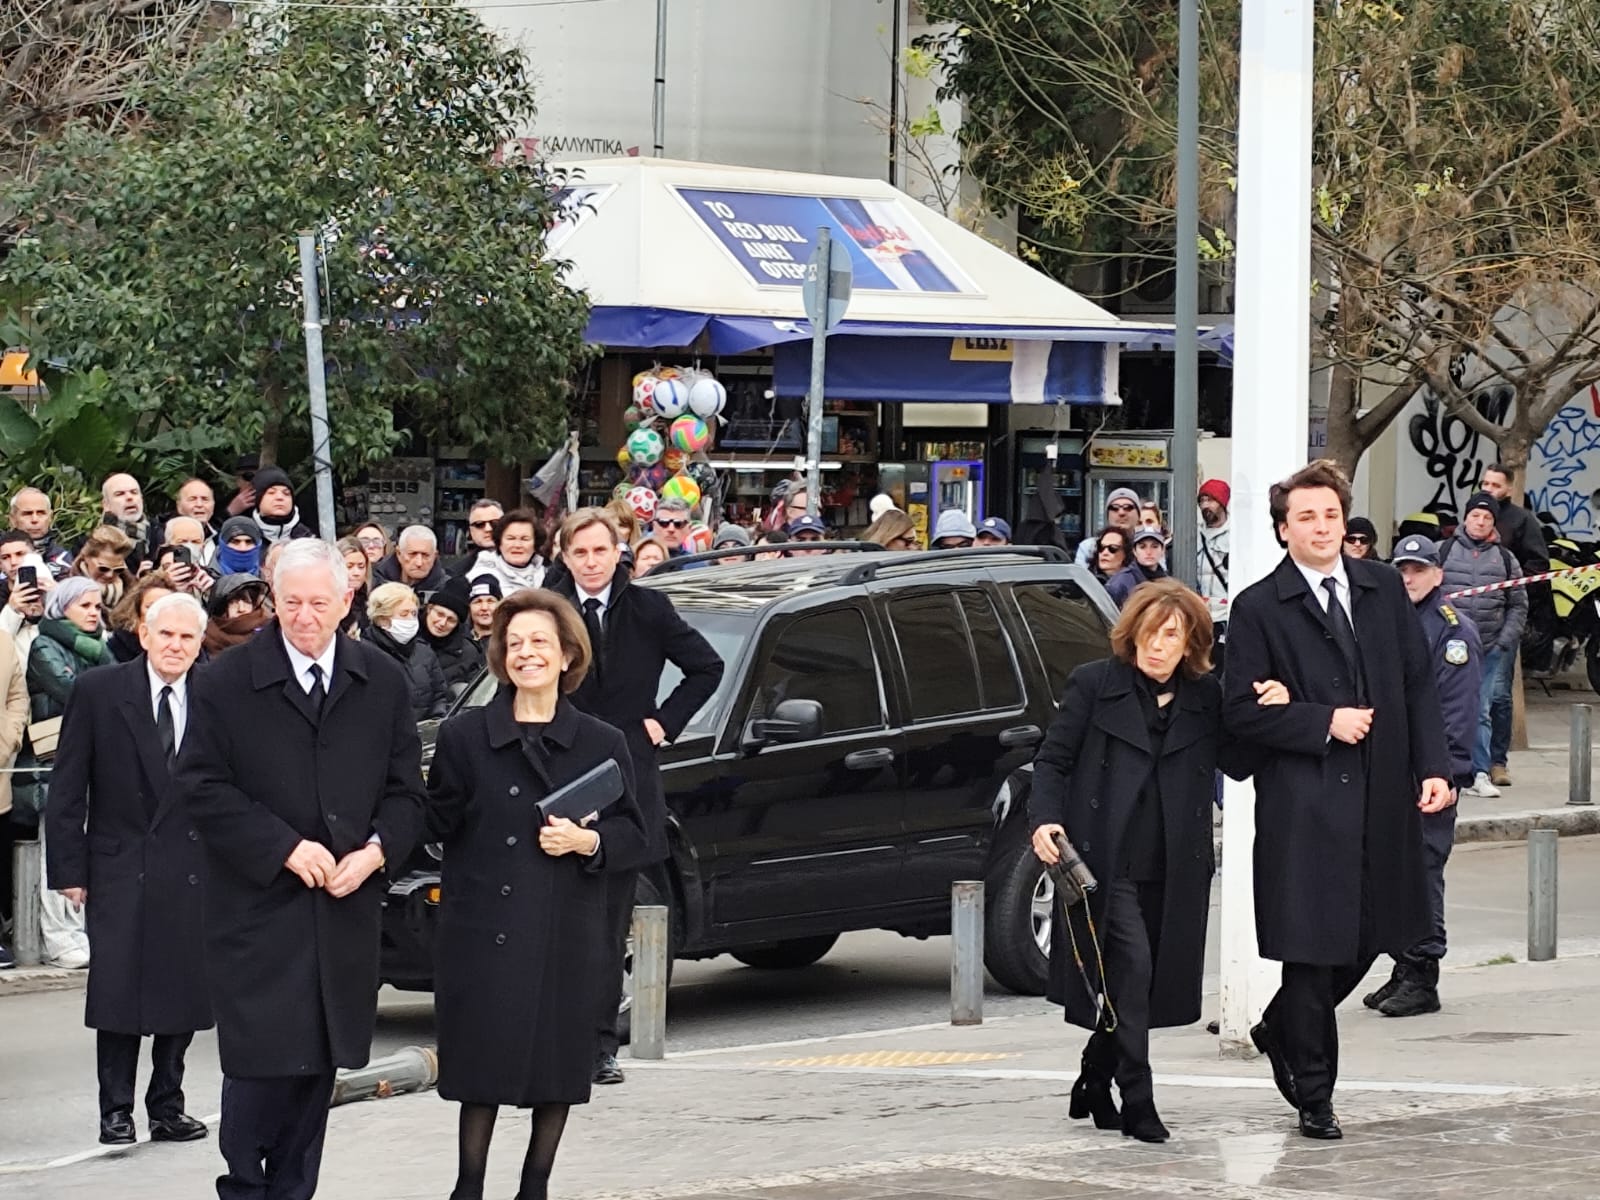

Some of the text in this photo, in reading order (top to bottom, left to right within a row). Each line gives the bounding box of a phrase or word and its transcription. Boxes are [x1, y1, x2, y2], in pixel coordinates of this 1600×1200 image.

[542, 135, 624, 155] ΚΑΛΛΥΝΤΙΚΑ
[702, 200, 736, 219] ΤΟ
[721, 220, 808, 243] RED BULL
[741, 240, 794, 261] ΔΙΝΕΙ
[759, 260, 807, 279] ΦΤΕΡ
